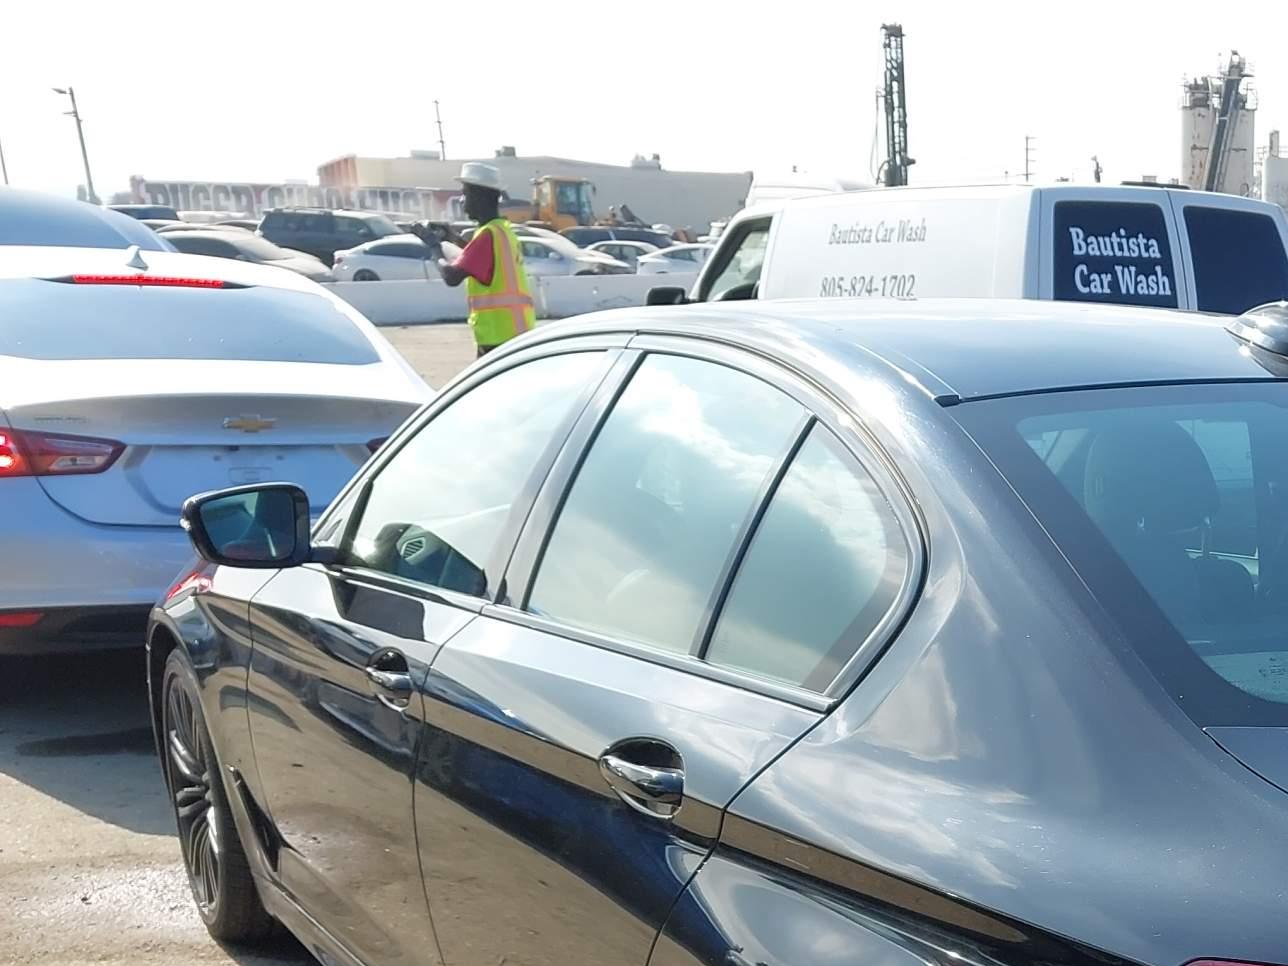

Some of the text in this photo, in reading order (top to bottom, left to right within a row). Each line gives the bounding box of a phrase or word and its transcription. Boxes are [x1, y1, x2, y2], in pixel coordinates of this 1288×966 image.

[828, 217, 927, 245] Bautista Car Wash
[1069, 227, 1161, 258] Bautista
[820, 274, 915, 297] 805-824-1702
[1074, 264, 1171, 295] Car Wash
